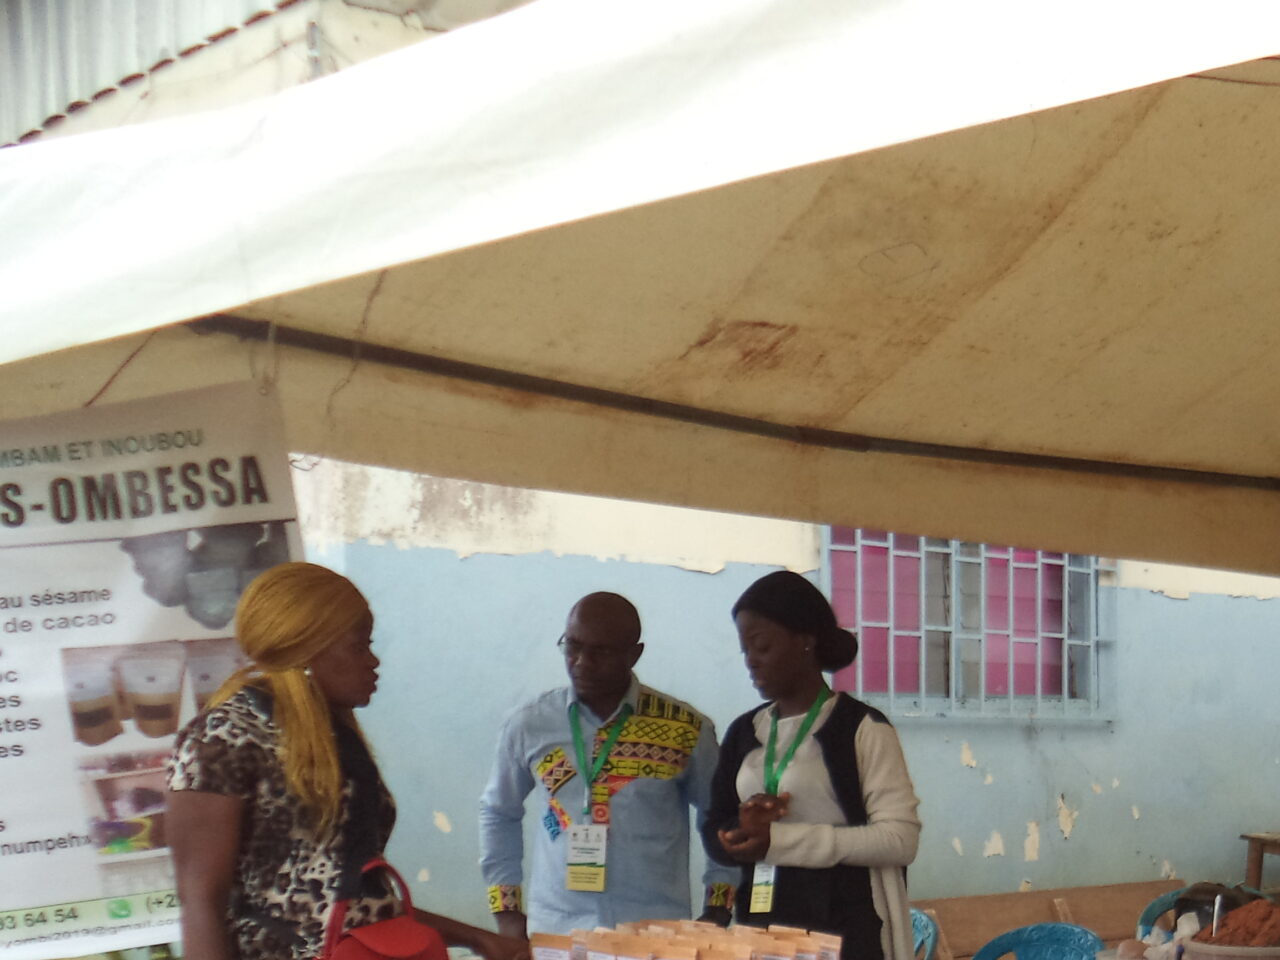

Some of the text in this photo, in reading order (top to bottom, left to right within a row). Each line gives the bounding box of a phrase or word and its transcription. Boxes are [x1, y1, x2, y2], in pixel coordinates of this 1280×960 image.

[66, 441, 93, 461] ET
[1, 456, 270, 527] S-OMBESSA
[0, 588, 112, 608] au sésame
[4, 613, 116, 633] de cacao
[24, 911, 47, 928] 64
[54, 907, 79, 923] 54
